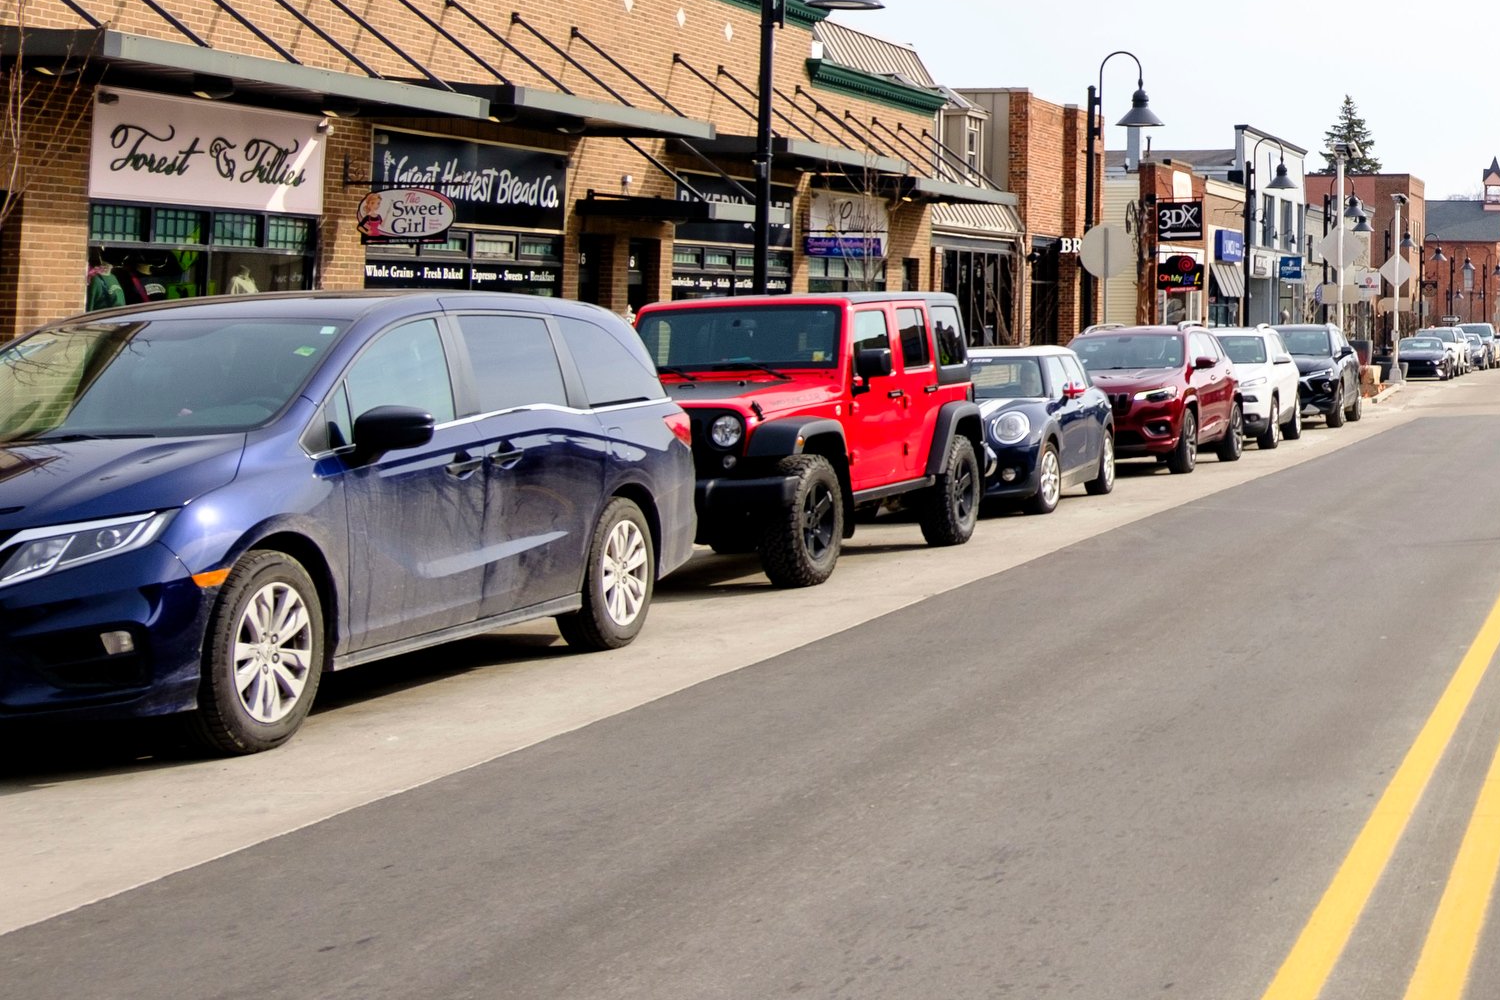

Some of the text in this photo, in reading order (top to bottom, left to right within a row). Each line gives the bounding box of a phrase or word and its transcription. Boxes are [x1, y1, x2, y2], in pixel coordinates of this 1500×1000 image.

[394, 155, 560, 209] Great Harvest Bread Co.
[392, 200, 444, 218] Sweet
[391, 216, 426, 235] Girl
[365, 265, 389, 277] Whole
[390, 265, 414, 278] Grains
[423, 267, 442, 279] Fresh
[443, 267, 463, 280] Baked
[1159, 273, 1170, 282] Oh
[1171, 274, 1183, 283] My
